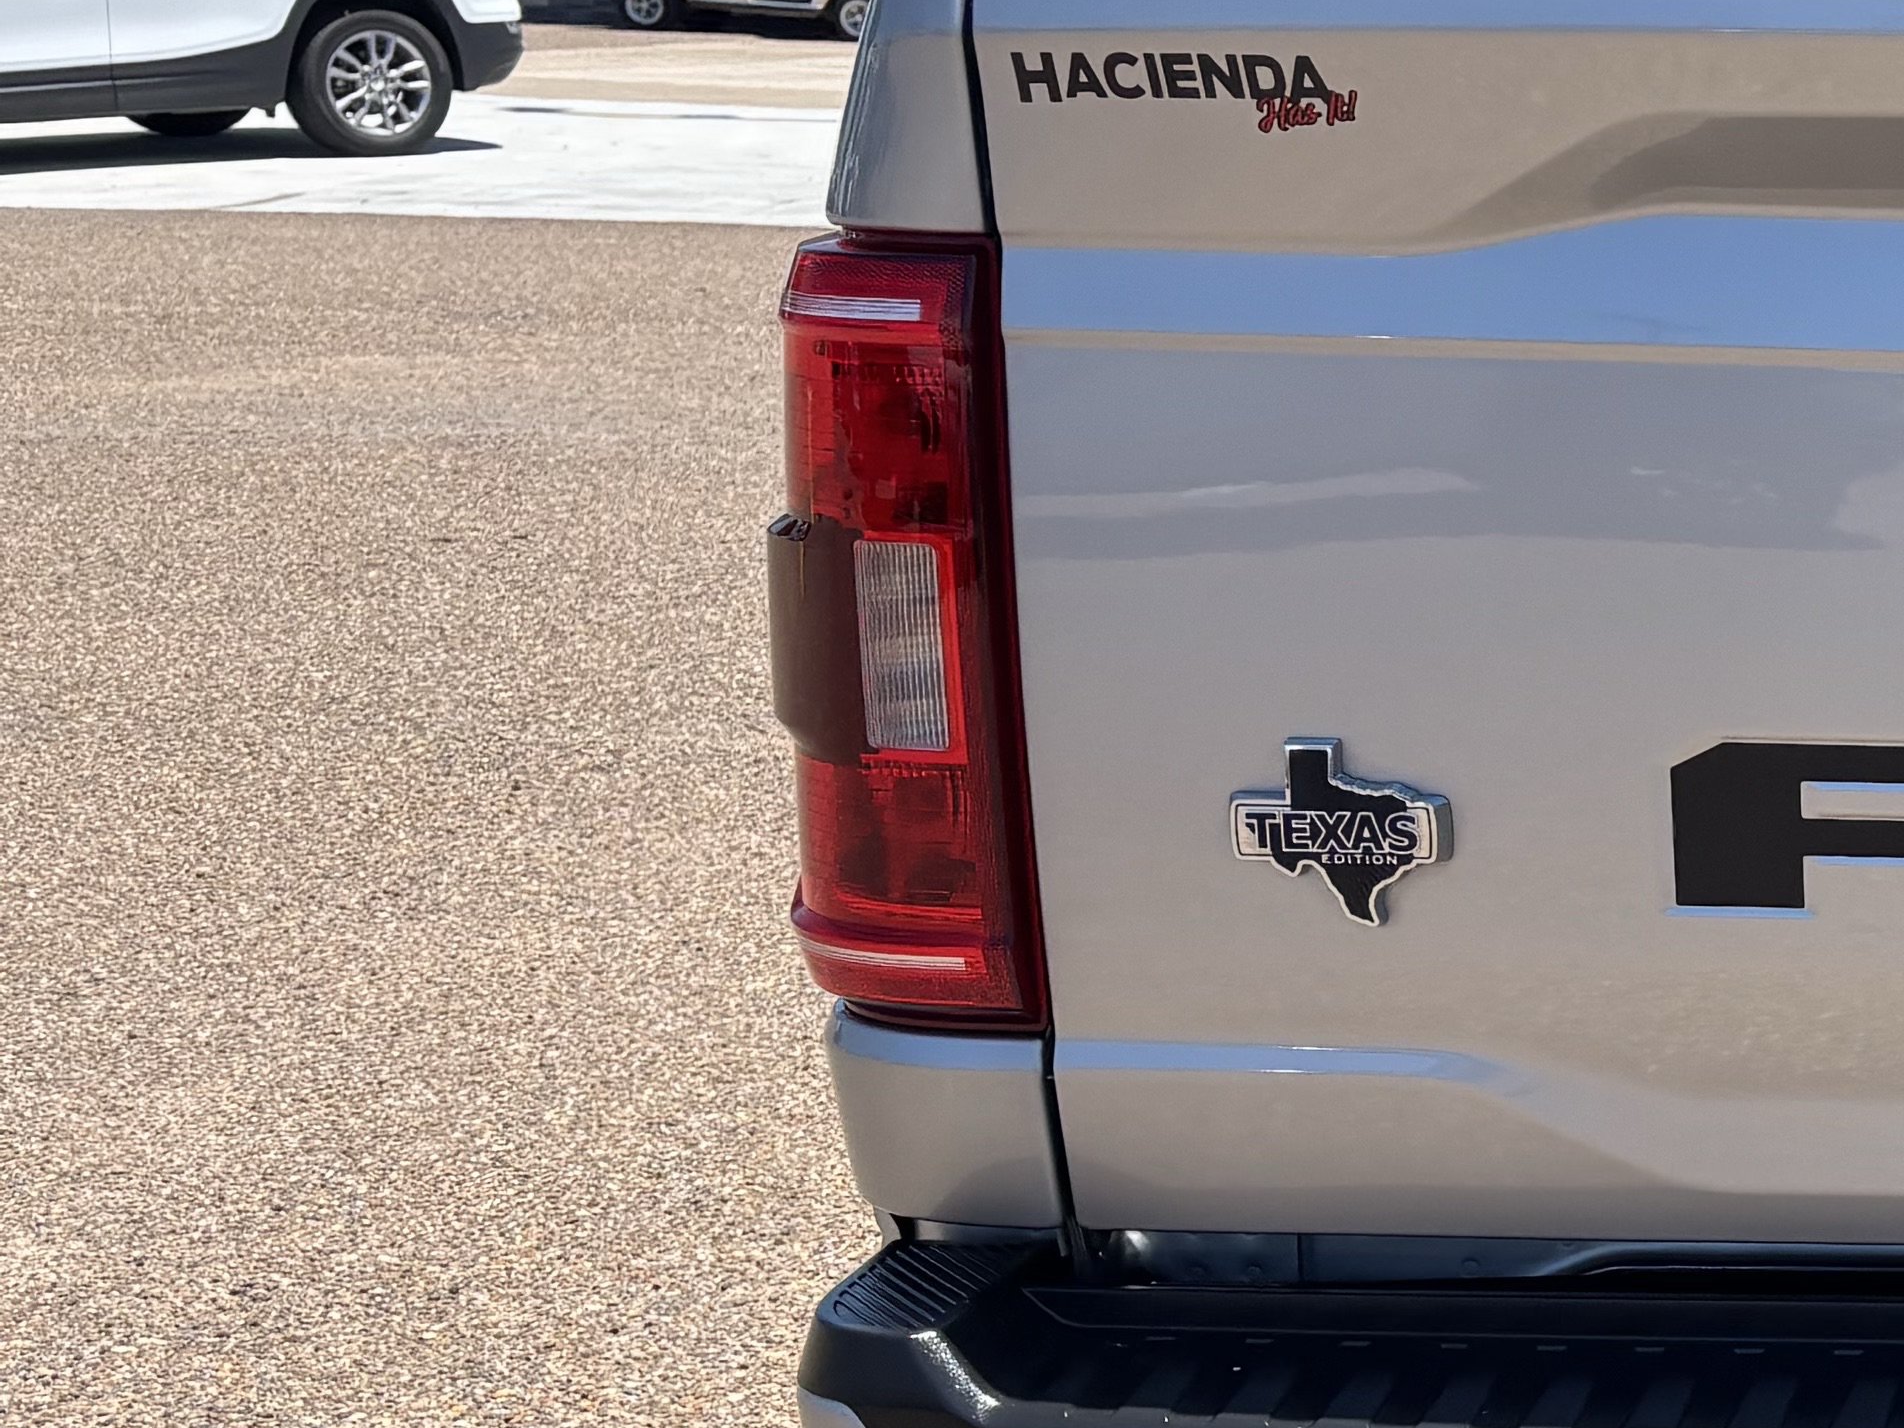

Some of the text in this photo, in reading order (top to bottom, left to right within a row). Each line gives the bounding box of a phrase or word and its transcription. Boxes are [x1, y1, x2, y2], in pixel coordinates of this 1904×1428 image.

[1010, 51, 1330, 103] HACIENDA
[1244, 810, 1420, 853] TEXAS
[1320, 852, 1399, 866] EDITION
